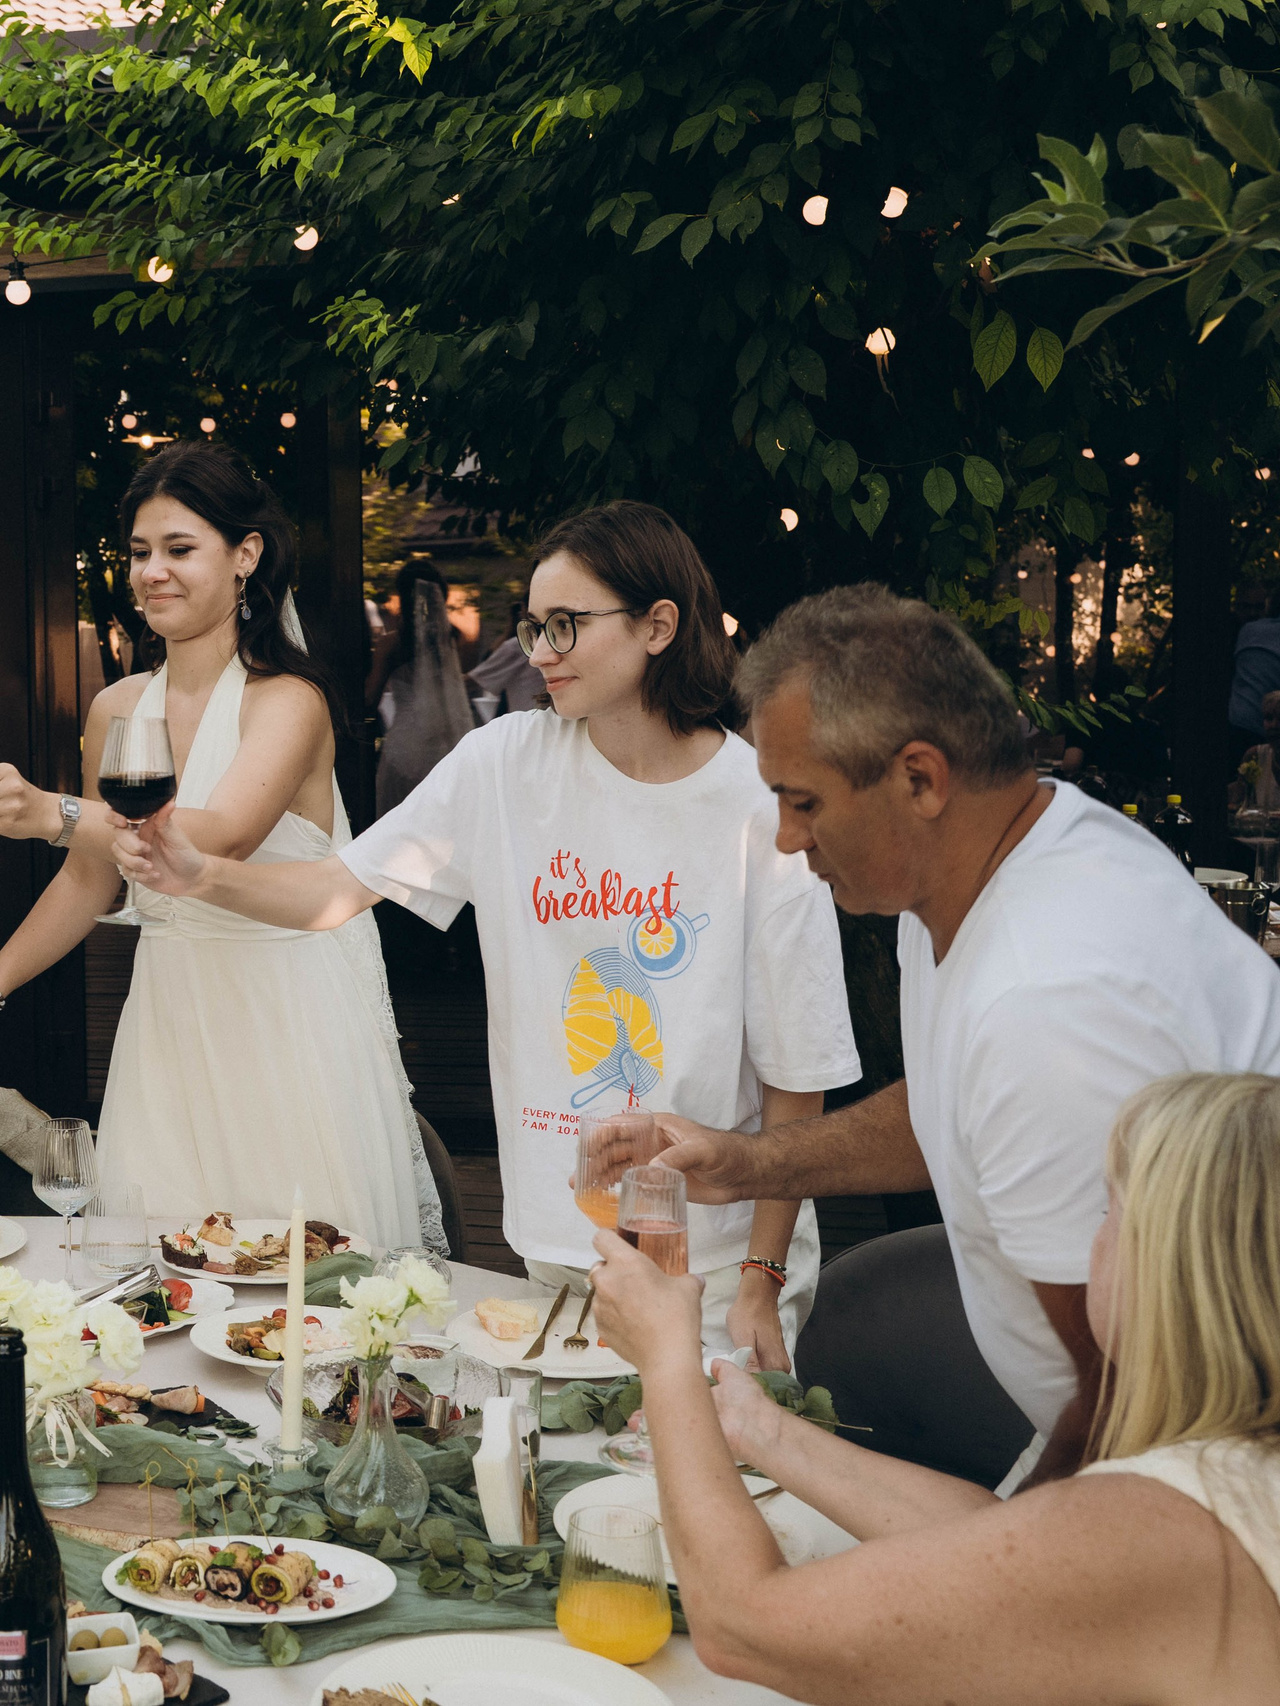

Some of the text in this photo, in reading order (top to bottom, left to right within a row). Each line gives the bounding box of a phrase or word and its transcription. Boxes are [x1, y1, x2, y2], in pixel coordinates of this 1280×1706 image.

[549, 849, 587, 889] it's
[522, 1107, 557, 1120] EVERY
[521, 1119, 528, 1127] 7
[530, 1121, 548, 1131] AM
[556, 1125, 571, 1136] 10
